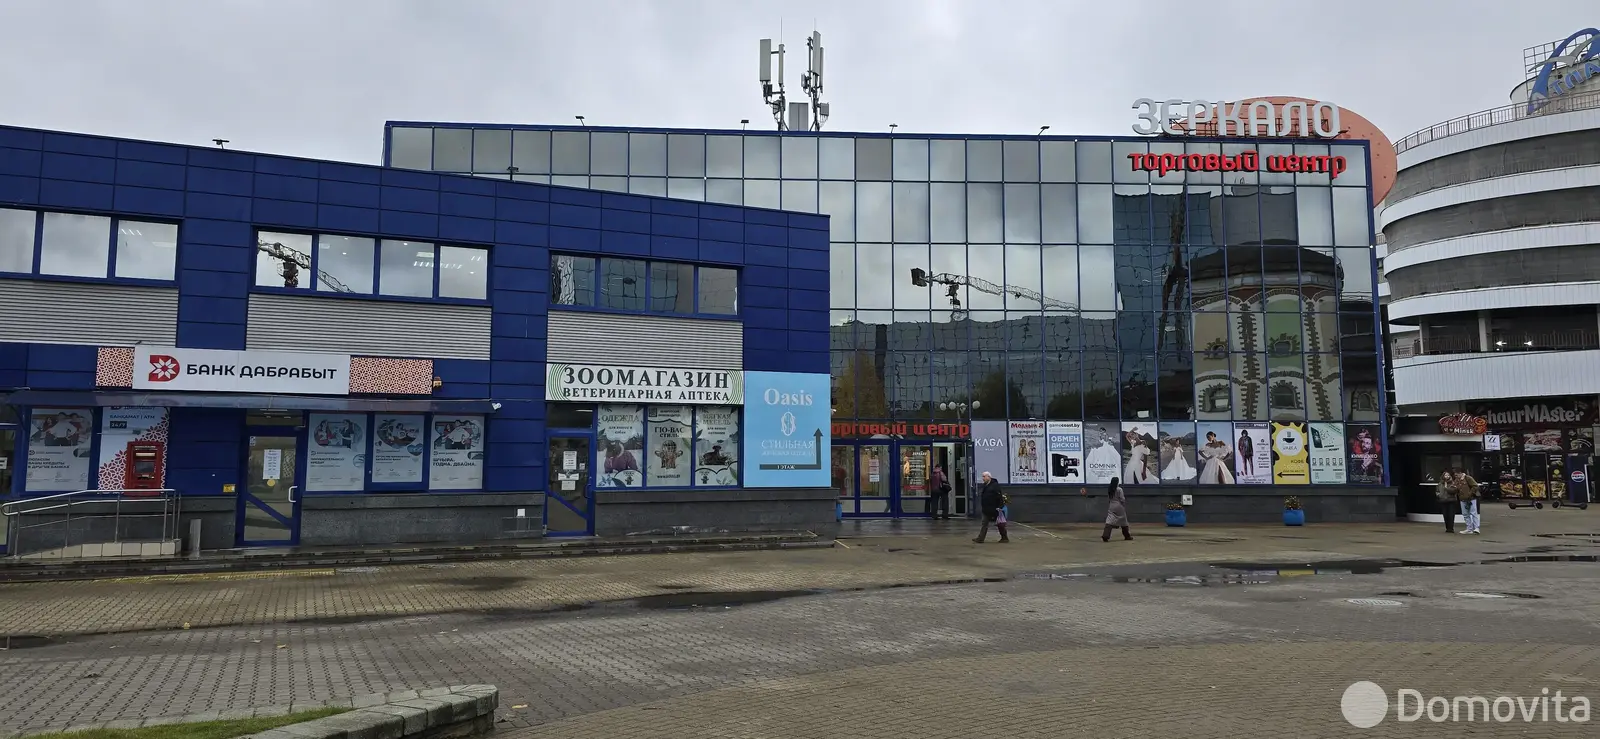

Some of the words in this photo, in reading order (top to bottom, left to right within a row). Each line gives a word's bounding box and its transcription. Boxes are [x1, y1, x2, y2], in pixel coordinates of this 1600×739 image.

[1131, 97, 1342, 138] ЗЕРКАЛО
[1128, 150, 1259, 177] торговый
[1267, 154, 1347, 179] центр
[186, 364, 236, 377] БАНК
[239, 365, 338, 380] ДАБРАБЫТ
[563, 366, 729, 389] ЗООМАГАЗИН
[563, 387, 672, 400] ВЕТЕРИНАРНАЯ
[678, 390, 730, 401] АПТЕКА
[764, 388, 813, 406] Oasis
[601, 414, 640, 423] ОДЕЖДА
[831, 421, 907, 438] орговый
[913, 424, 970, 438] центр
[761, 439, 815, 449] СТИЛЬНАЯ
[1051, 435, 1080, 443] ОБМЕН
